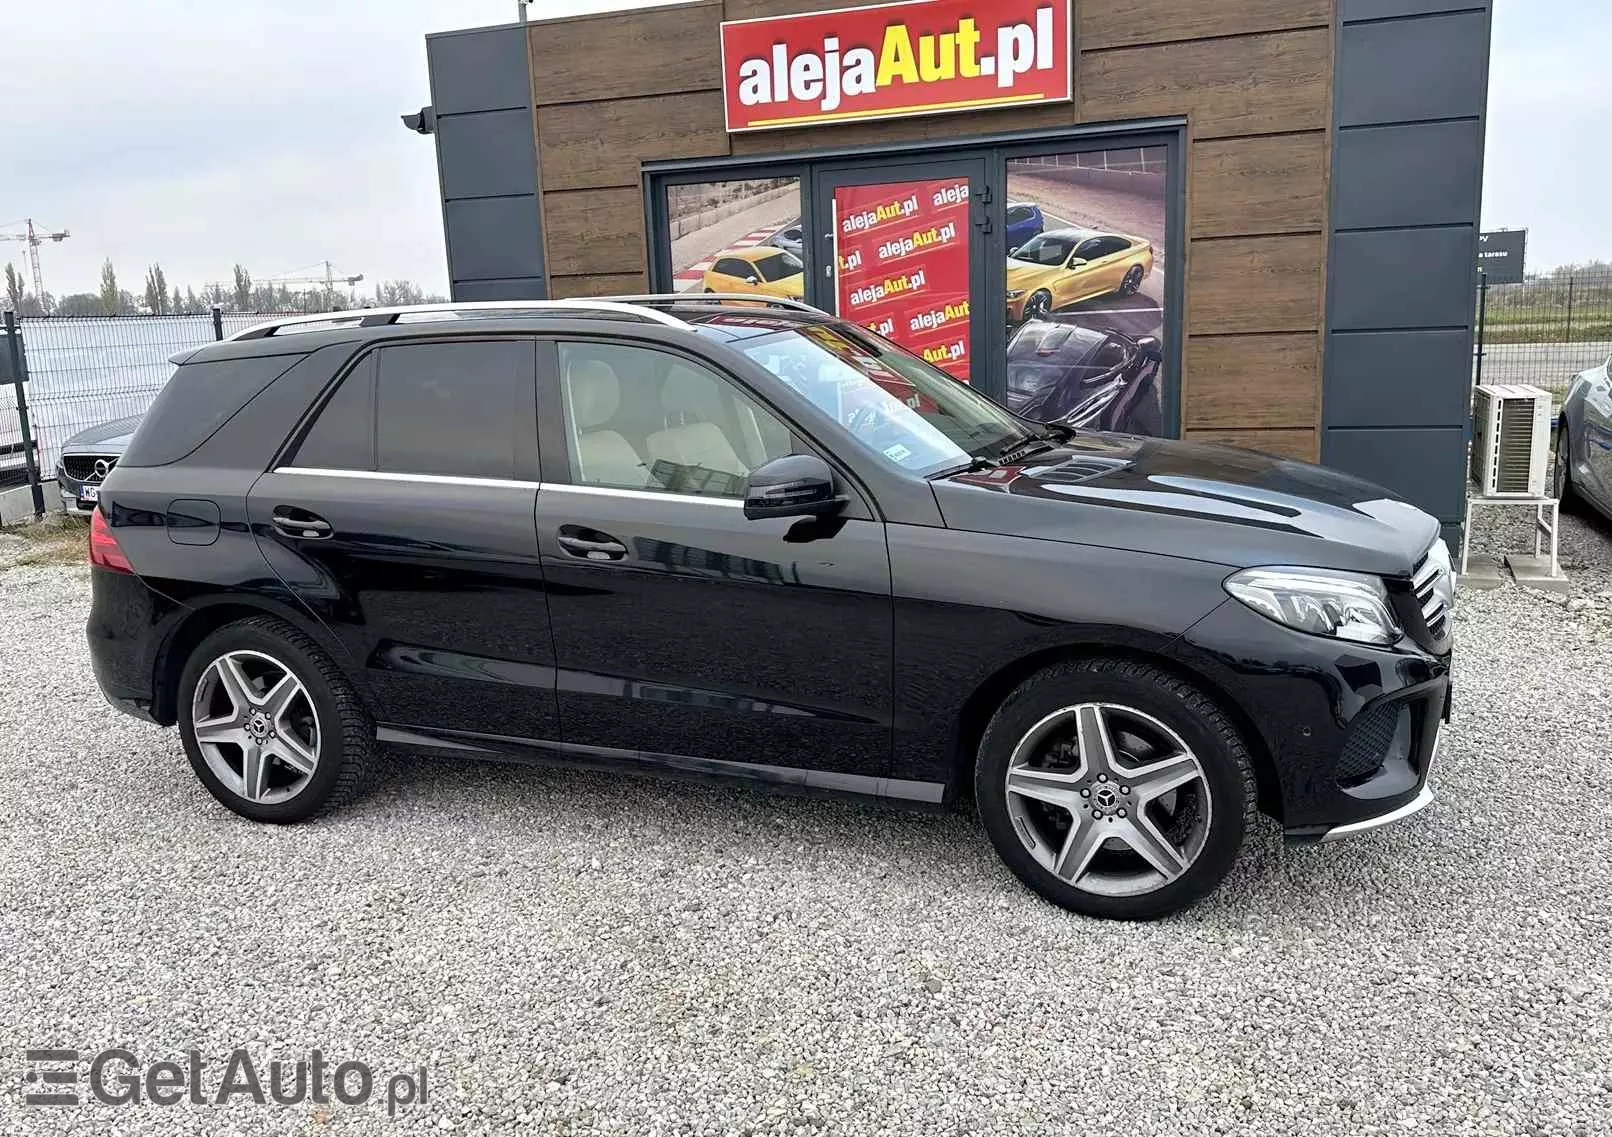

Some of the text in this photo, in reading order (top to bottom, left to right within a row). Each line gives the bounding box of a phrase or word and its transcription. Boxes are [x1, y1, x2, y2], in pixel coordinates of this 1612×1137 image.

[739, 8, 1053, 111] alejaAut.pl
[842, 195, 919, 233] alejaAut.pl
[878, 223, 956, 259] alejaAut.pl
[850, 270, 926, 305] alejaAut.pl
